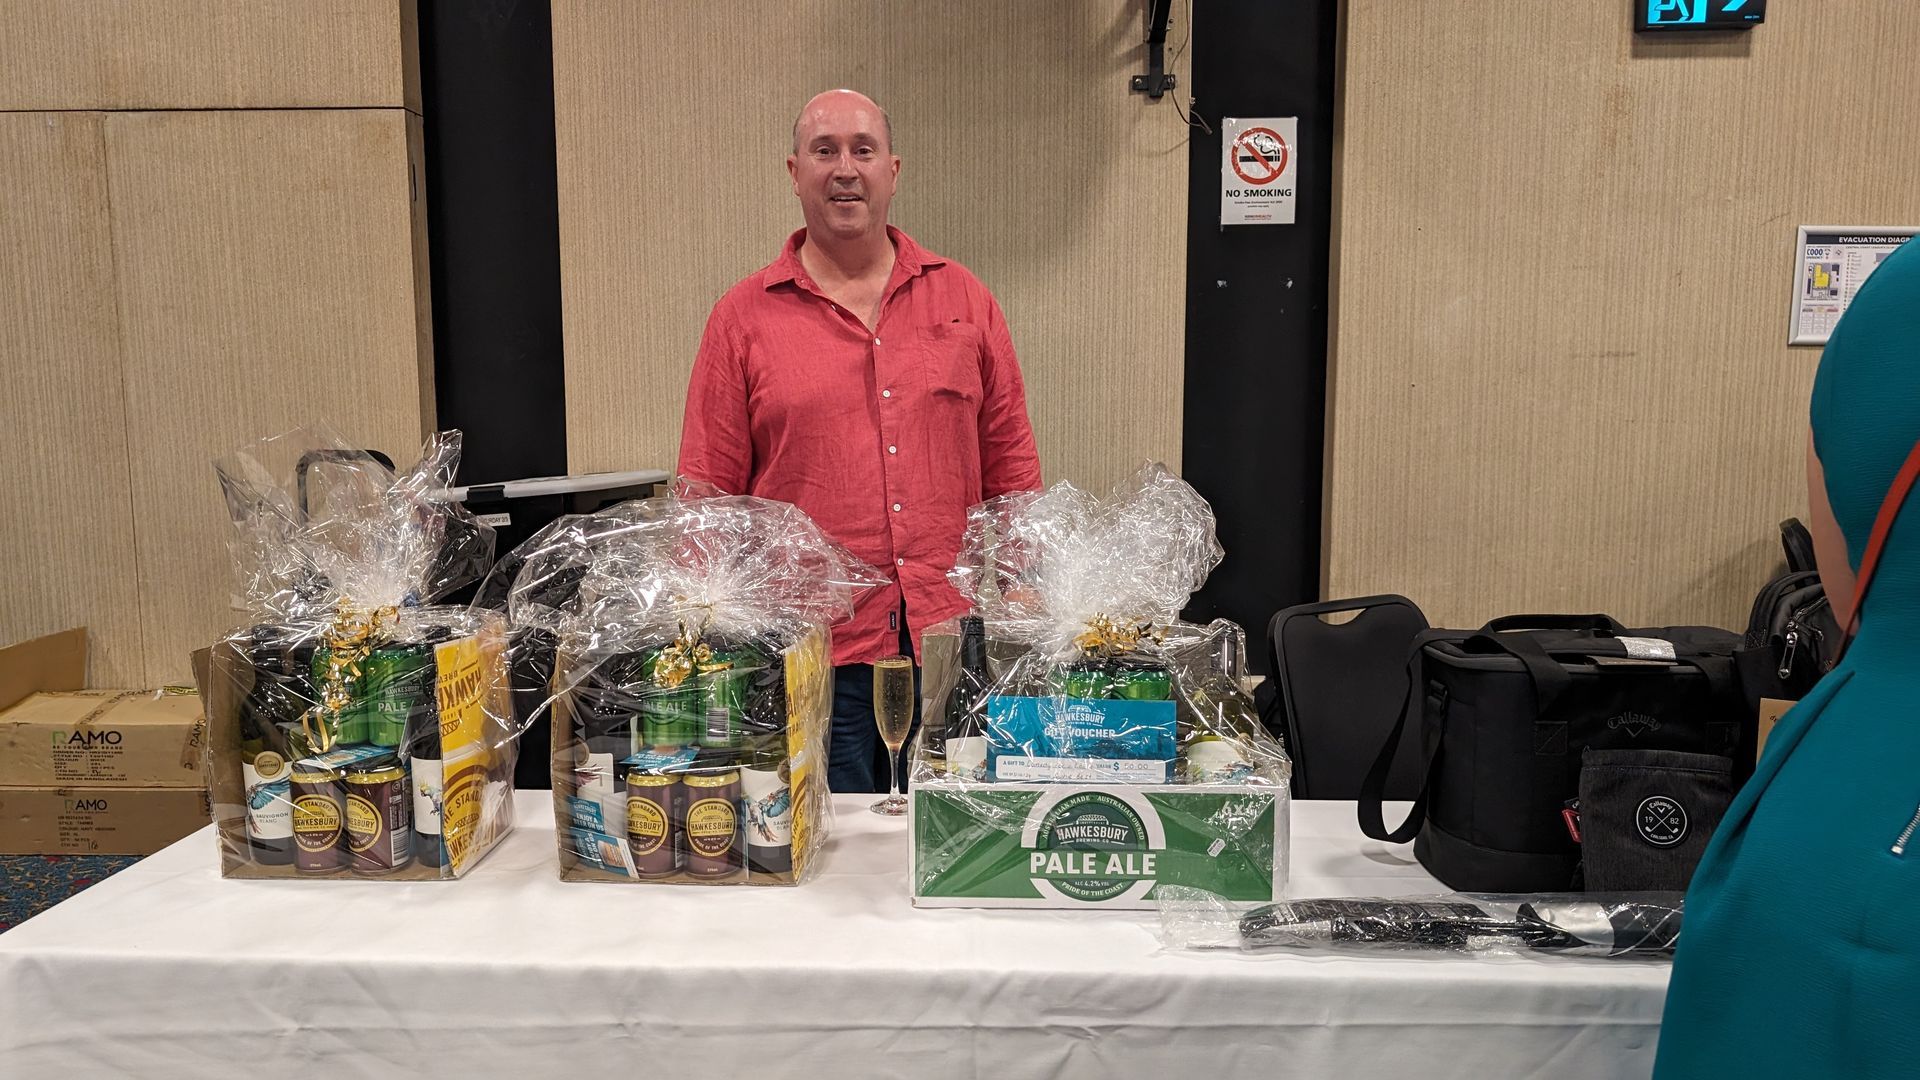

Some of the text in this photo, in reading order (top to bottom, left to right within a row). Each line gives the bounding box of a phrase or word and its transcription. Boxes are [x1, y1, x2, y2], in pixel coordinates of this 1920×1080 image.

[1244, 189, 1292, 197] SMOKING
[378, 702, 407, 712] PALE
[666, 701, 687, 712] ALE
[1056, 712, 1105, 724] HAWKESBURY
[1608, 711, 1662, 731] Callaway
[52, 730, 122, 745] RAMO
[1070, 728, 1116, 738] VOUCHER
[1113, 762, 1119, 770] $
[64, 800, 108, 810] RAMO
[704, 804, 730, 816] STANDARD
[1070, 794, 1090, 806] MADE
[1097, 795, 1134, 820] AUSTRALIAN
[1131, 816, 1144, 840] OWNED
[690, 822, 734, 831] HAWKESBURY
[1056, 826, 1128, 840] HAWKESBURY
[1030, 852, 1156, 875] PALE ALE
[1062, 882, 1080, 894] PRIDE
[1104, 882, 1124, 896] COAST
